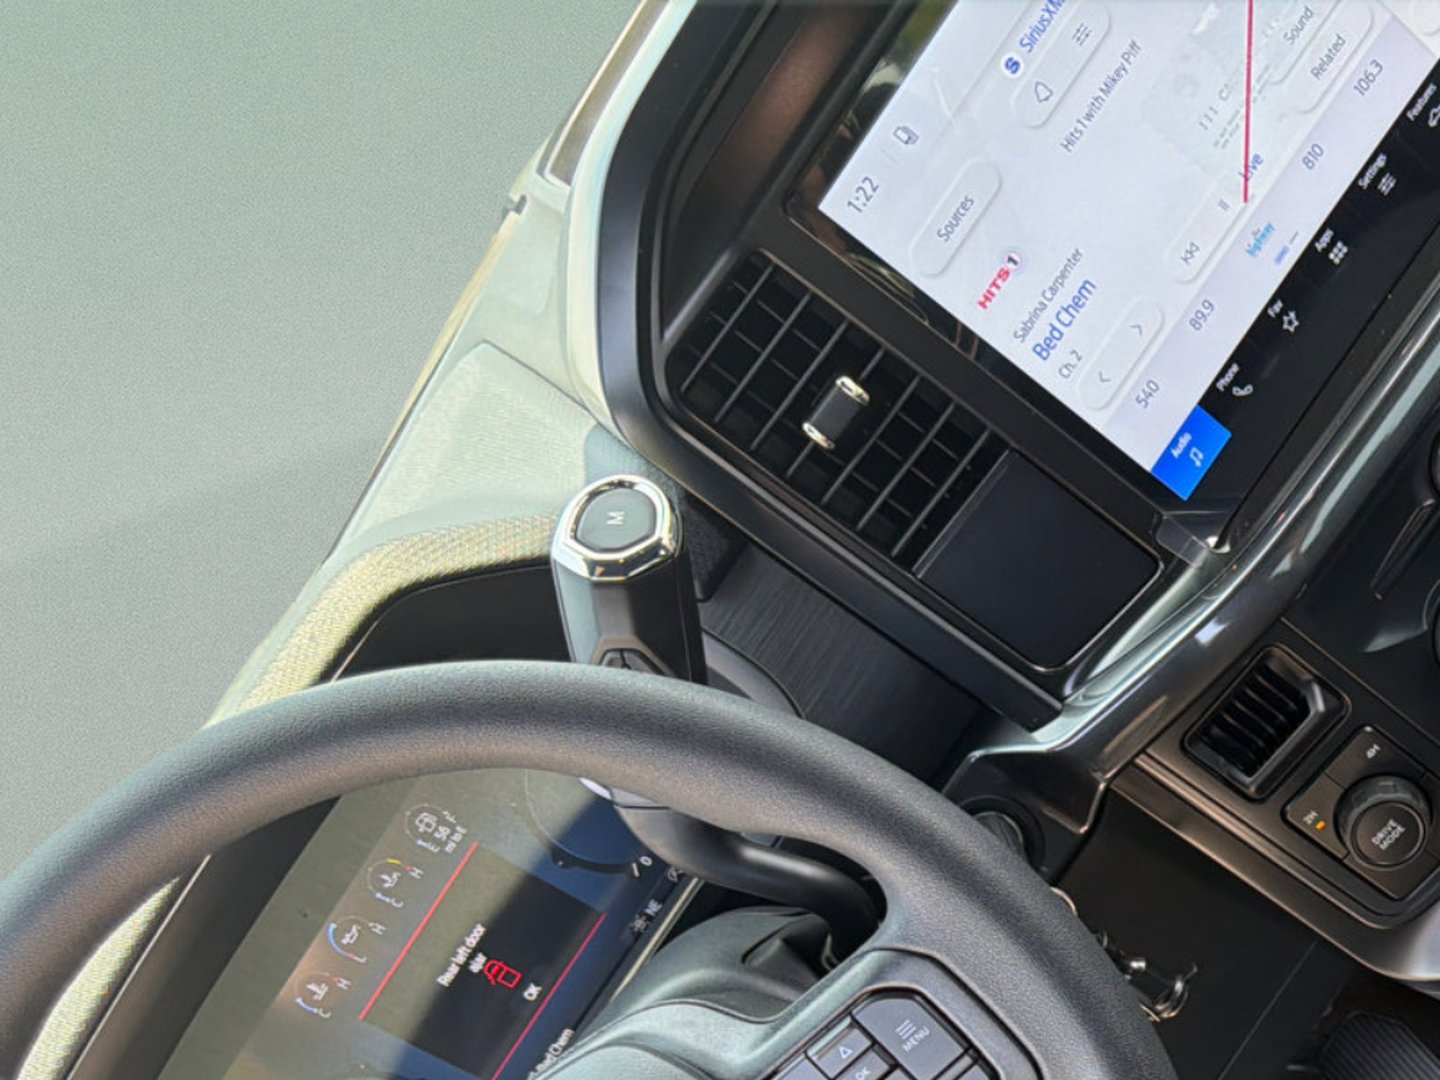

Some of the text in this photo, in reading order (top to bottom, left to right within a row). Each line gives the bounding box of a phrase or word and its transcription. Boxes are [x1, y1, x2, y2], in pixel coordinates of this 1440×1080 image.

[1283, 6, 1315, 45] Sound
[1310, 34, 1347, 80] Related
[1353, 58, 1384, 97] 106.3
[1060, 127, 1084, 153] Hits
[1083, 95, 1106, 122] with
[1099, 62, 1128, 98] Mikey
[1406, 83, 1438, 121] Features
[1301, 143, 1325, 171] 810
[1358, 152, 1388, 189] Settings
[847, 176, 879, 213] 1:22
[936, 194, 975, 243] Sources
[1315, 228, 1334, 252] Apps
[978, 267, 1011, 310] HITS
[1013, 248, 1083, 344] Sabrina Carpenter
[1032, 279, 1097, 361] Bed Chem
[1188, 299, 1216, 332] 89.9
[1267, 300, 1284, 318] Fav
[1070, 349, 1082, 362] 2
[1216, 363, 1241, 392] Phone
[1134, 379, 1160, 409] 540
[1170, 432, 1193, 459] Audio
[1372, 819, 1397, 844] DRIVE
[1380, 825, 1406, 850] MODE
[643, 899, 663, 917] NE
[437, 923, 486, 987] Rear left door
[469, 952, 487, 973] ajar
[523, 982, 543, 1000] OK
[902, 1026, 930, 1052] MENU
[855, 1067, 871, 1080] OK
